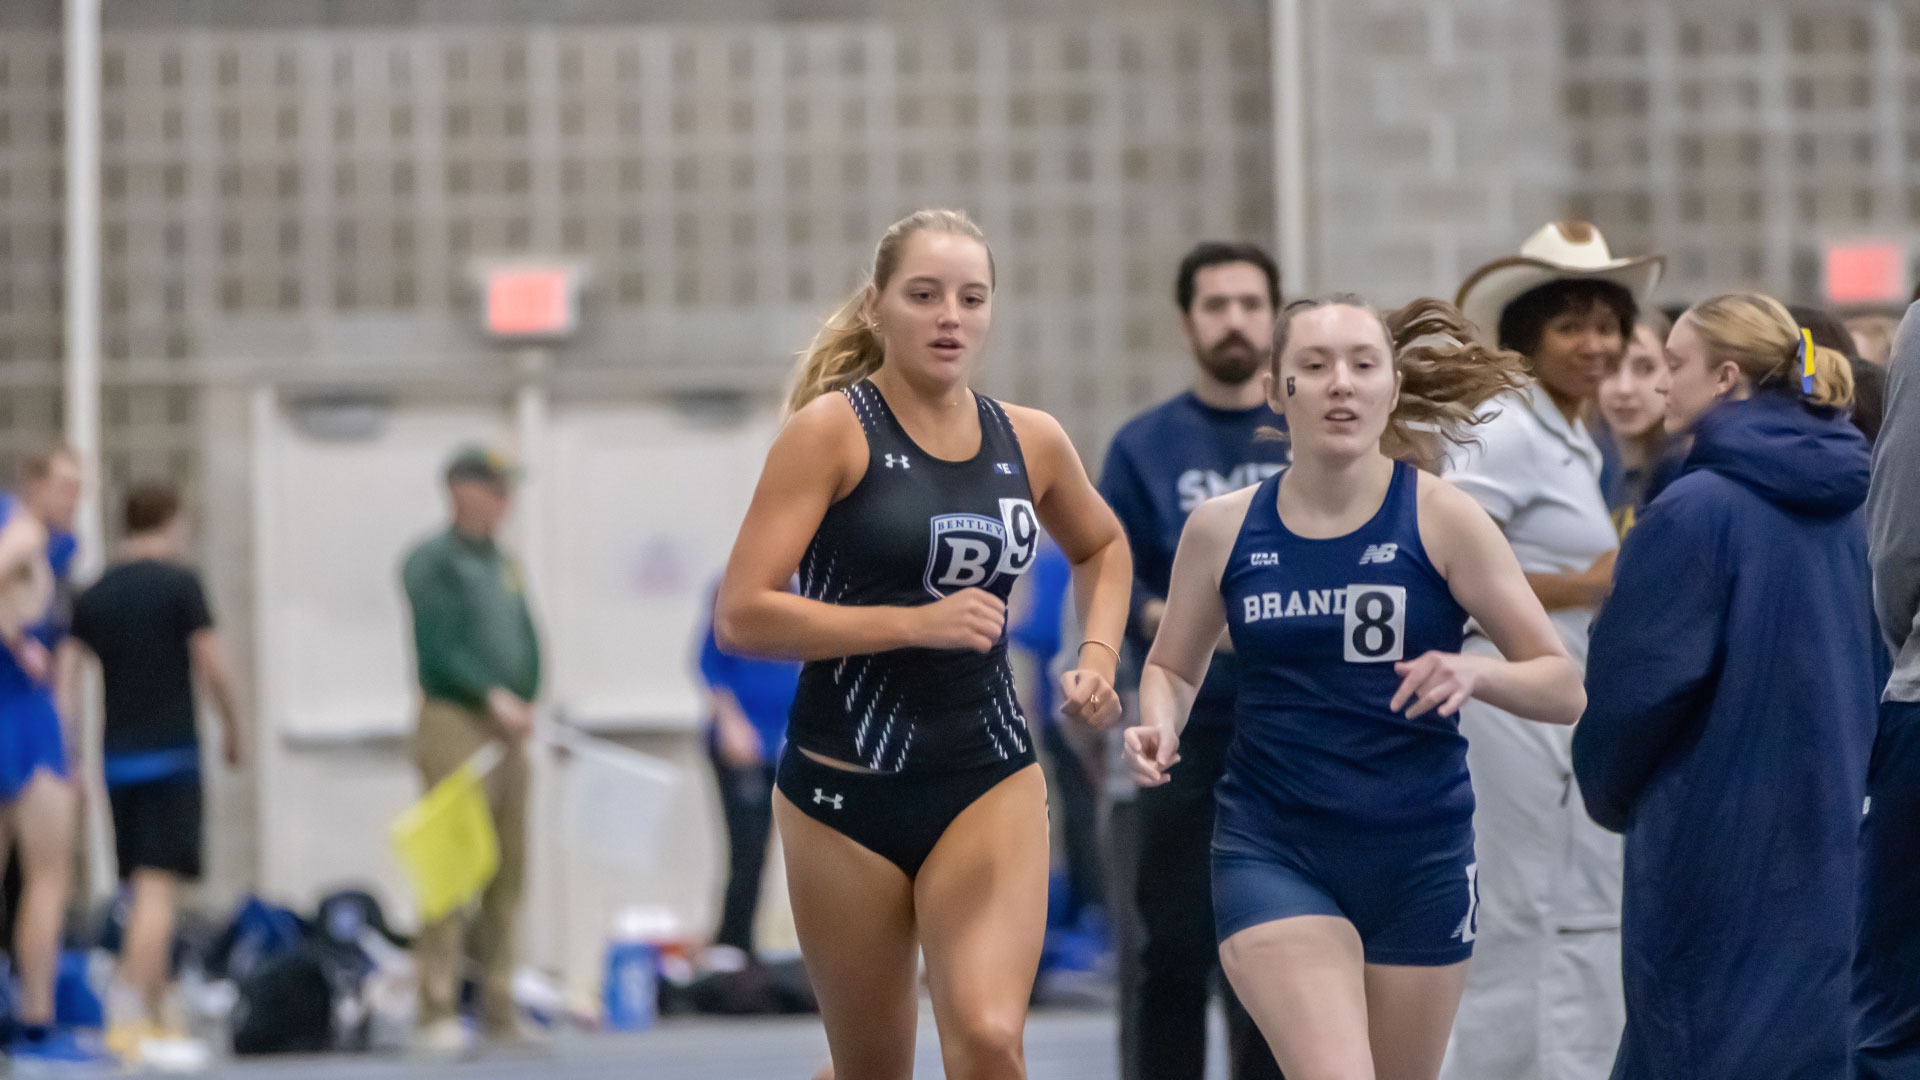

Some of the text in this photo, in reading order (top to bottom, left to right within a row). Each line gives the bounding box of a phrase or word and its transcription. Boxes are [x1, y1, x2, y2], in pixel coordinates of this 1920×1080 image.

[938, 519, 1003, 535] BENTLEY
[1010, 504, 1038, 569] 9
[937, 537, 991, 586] B
[1352, 591, 1396, 658] 8
